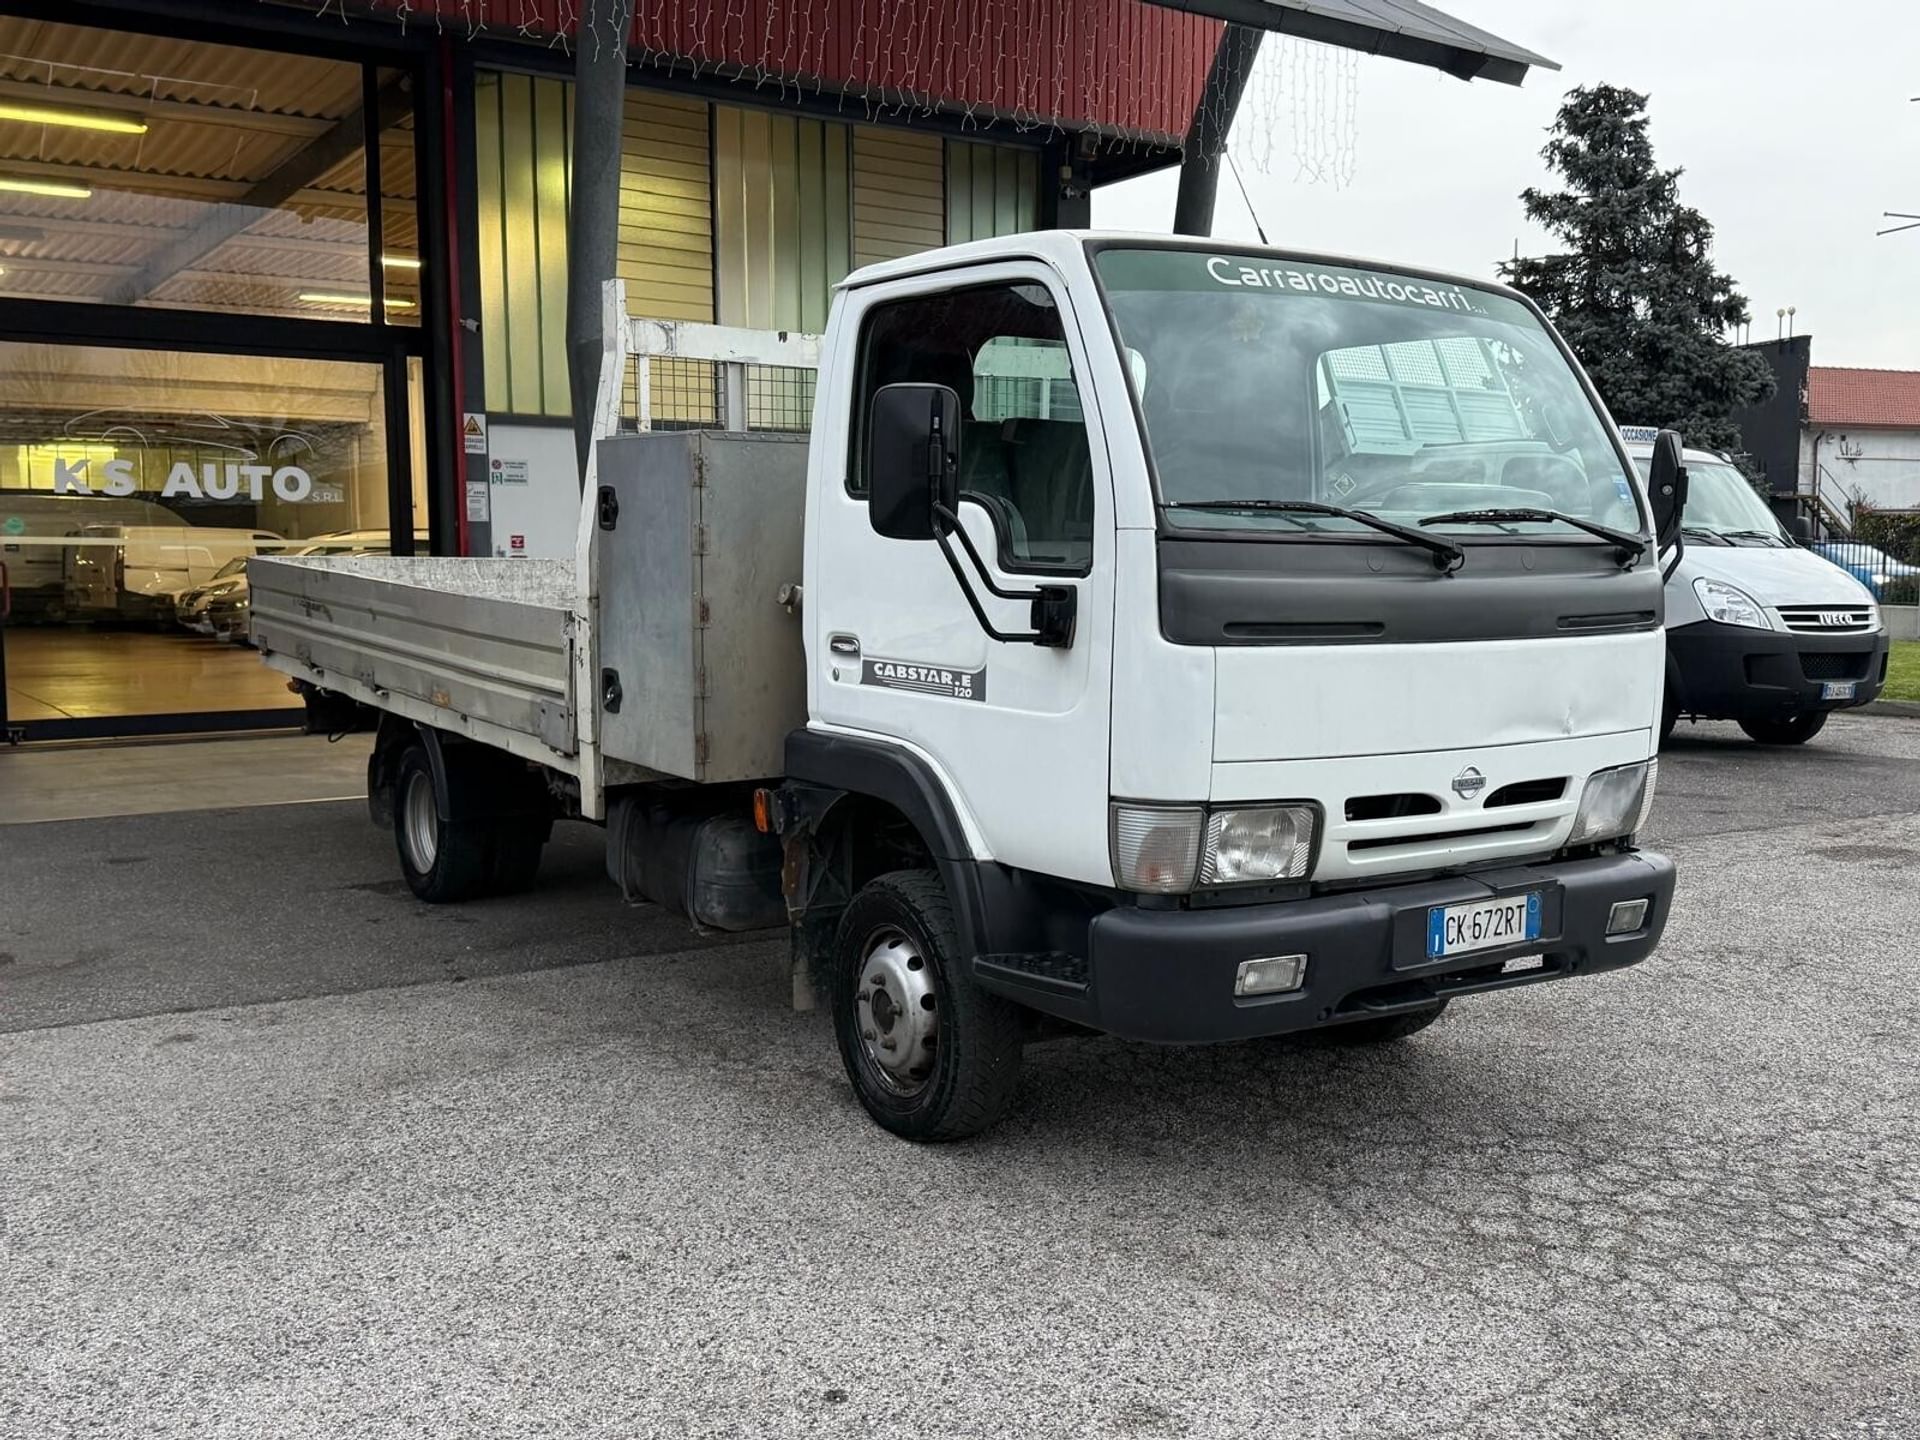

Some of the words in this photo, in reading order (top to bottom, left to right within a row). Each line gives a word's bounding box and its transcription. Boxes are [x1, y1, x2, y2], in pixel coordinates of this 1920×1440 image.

[1622, 427, 1657, 441] OCCASIONE
[161, 462, 312, 501] AUTO
[1819, 611, 1853, 626] IVECO
[953, 686, 972, 698] 120
[1457, 777, 1484, 788] NISSAN
[1471, 903, 1526, 942] 672RT
